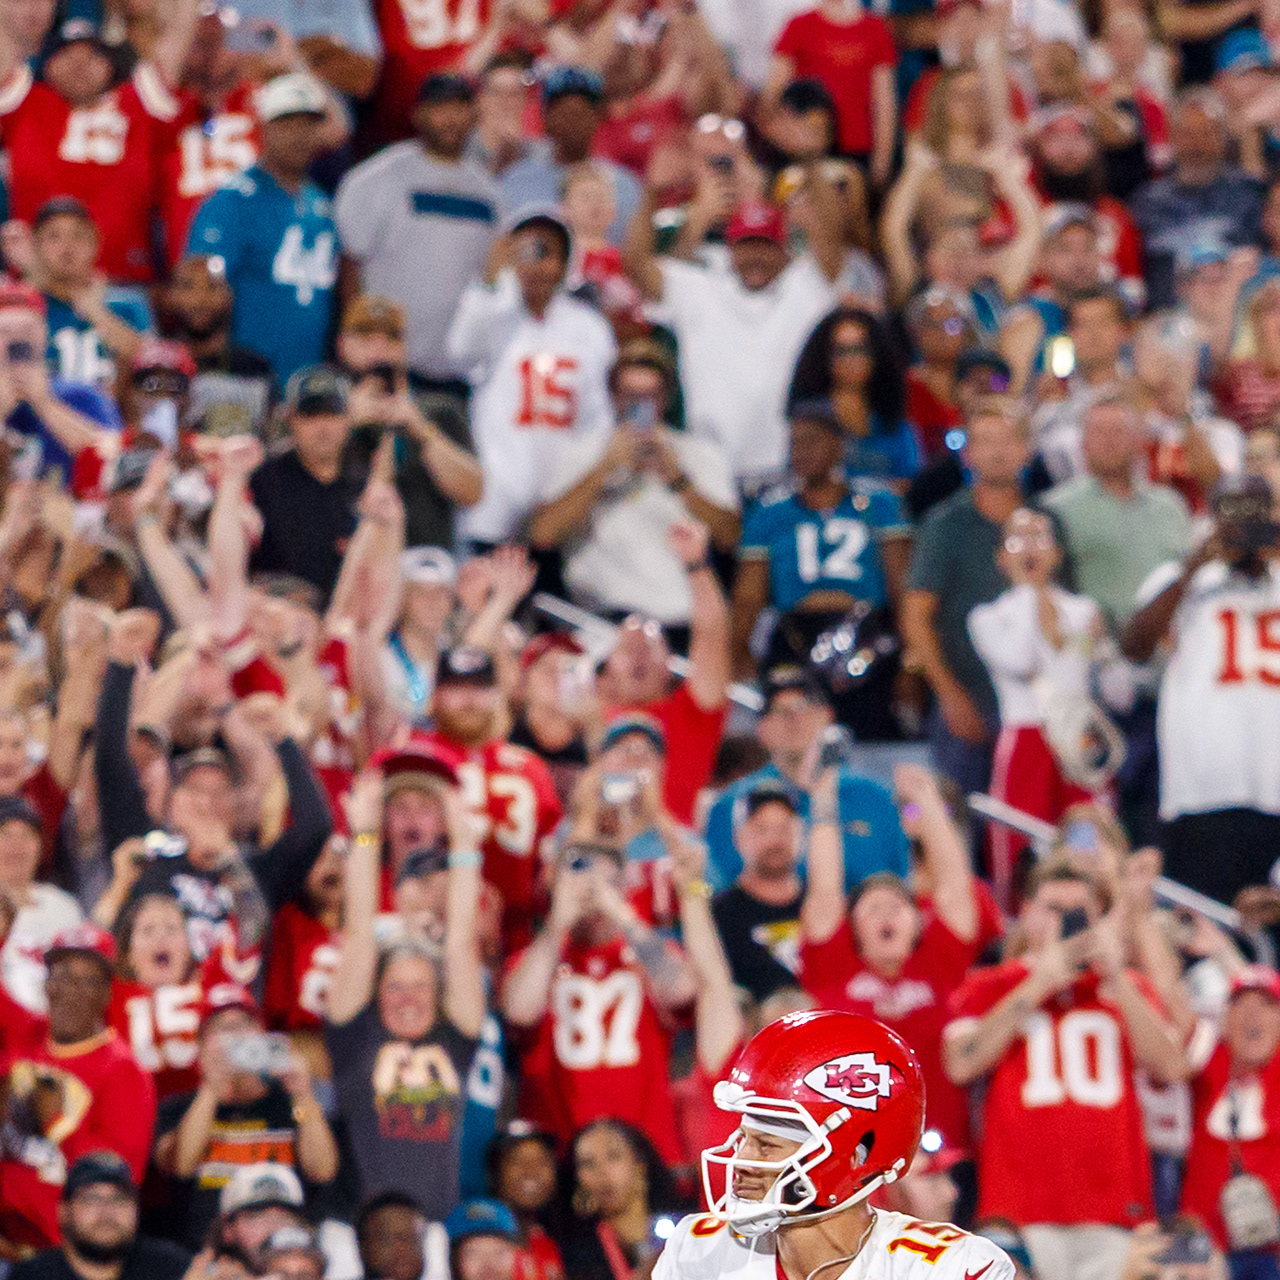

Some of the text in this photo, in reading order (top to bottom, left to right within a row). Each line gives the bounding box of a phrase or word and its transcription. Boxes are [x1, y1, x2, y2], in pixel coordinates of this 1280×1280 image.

[795, 518, 865, 581] 12
[553, 970, 644, 1070] 87
[1022, 1008, 1124, 1110] 10
